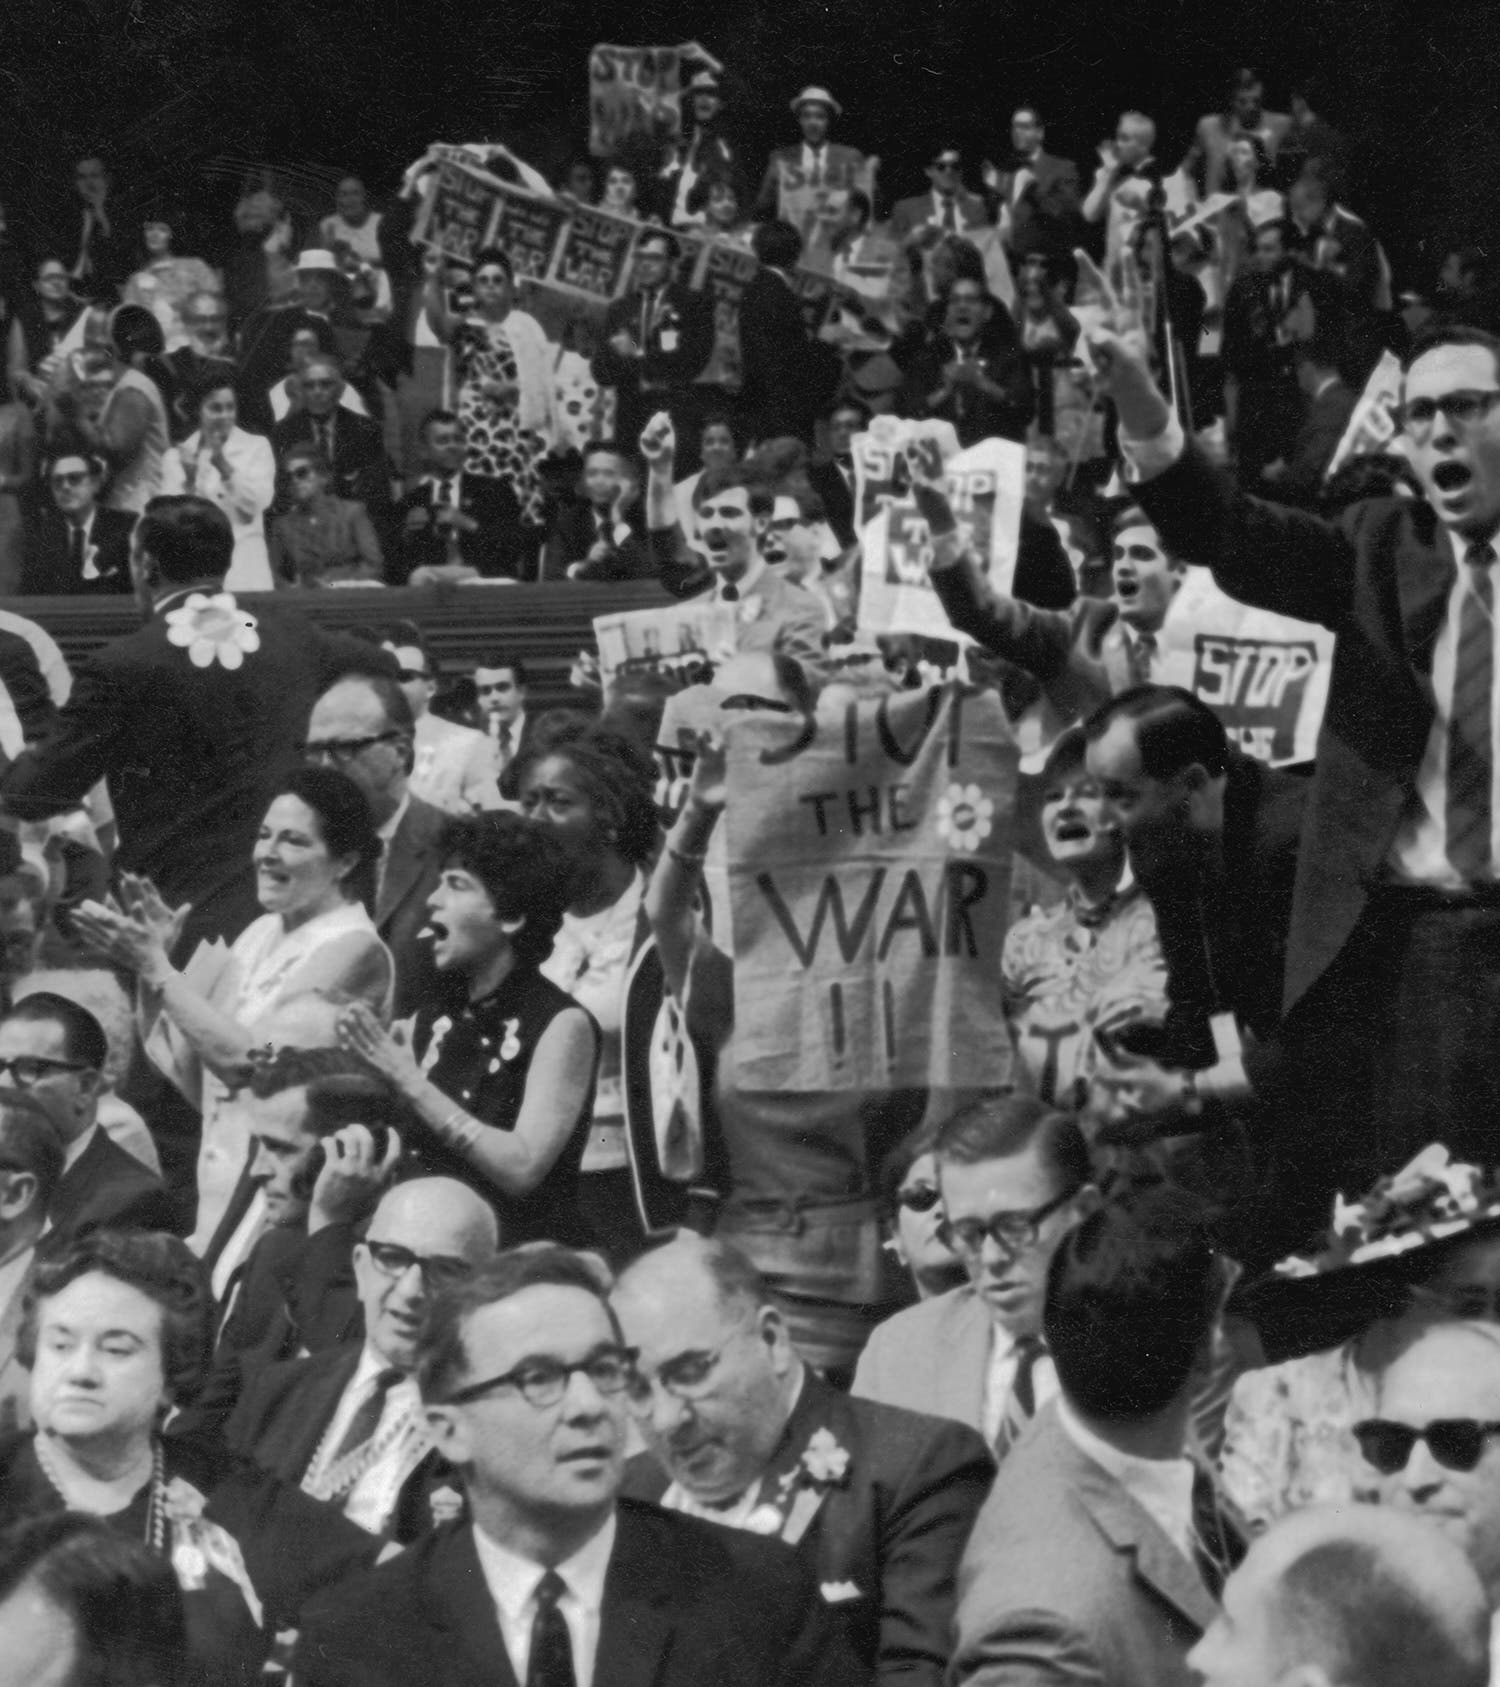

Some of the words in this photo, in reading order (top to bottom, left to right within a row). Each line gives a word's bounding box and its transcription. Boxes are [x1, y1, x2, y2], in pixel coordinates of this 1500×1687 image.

[1197, 640, 1312, 708] STOP
[799, 783, 919, 837] THE
[757, 860, 990, 969] WAR
